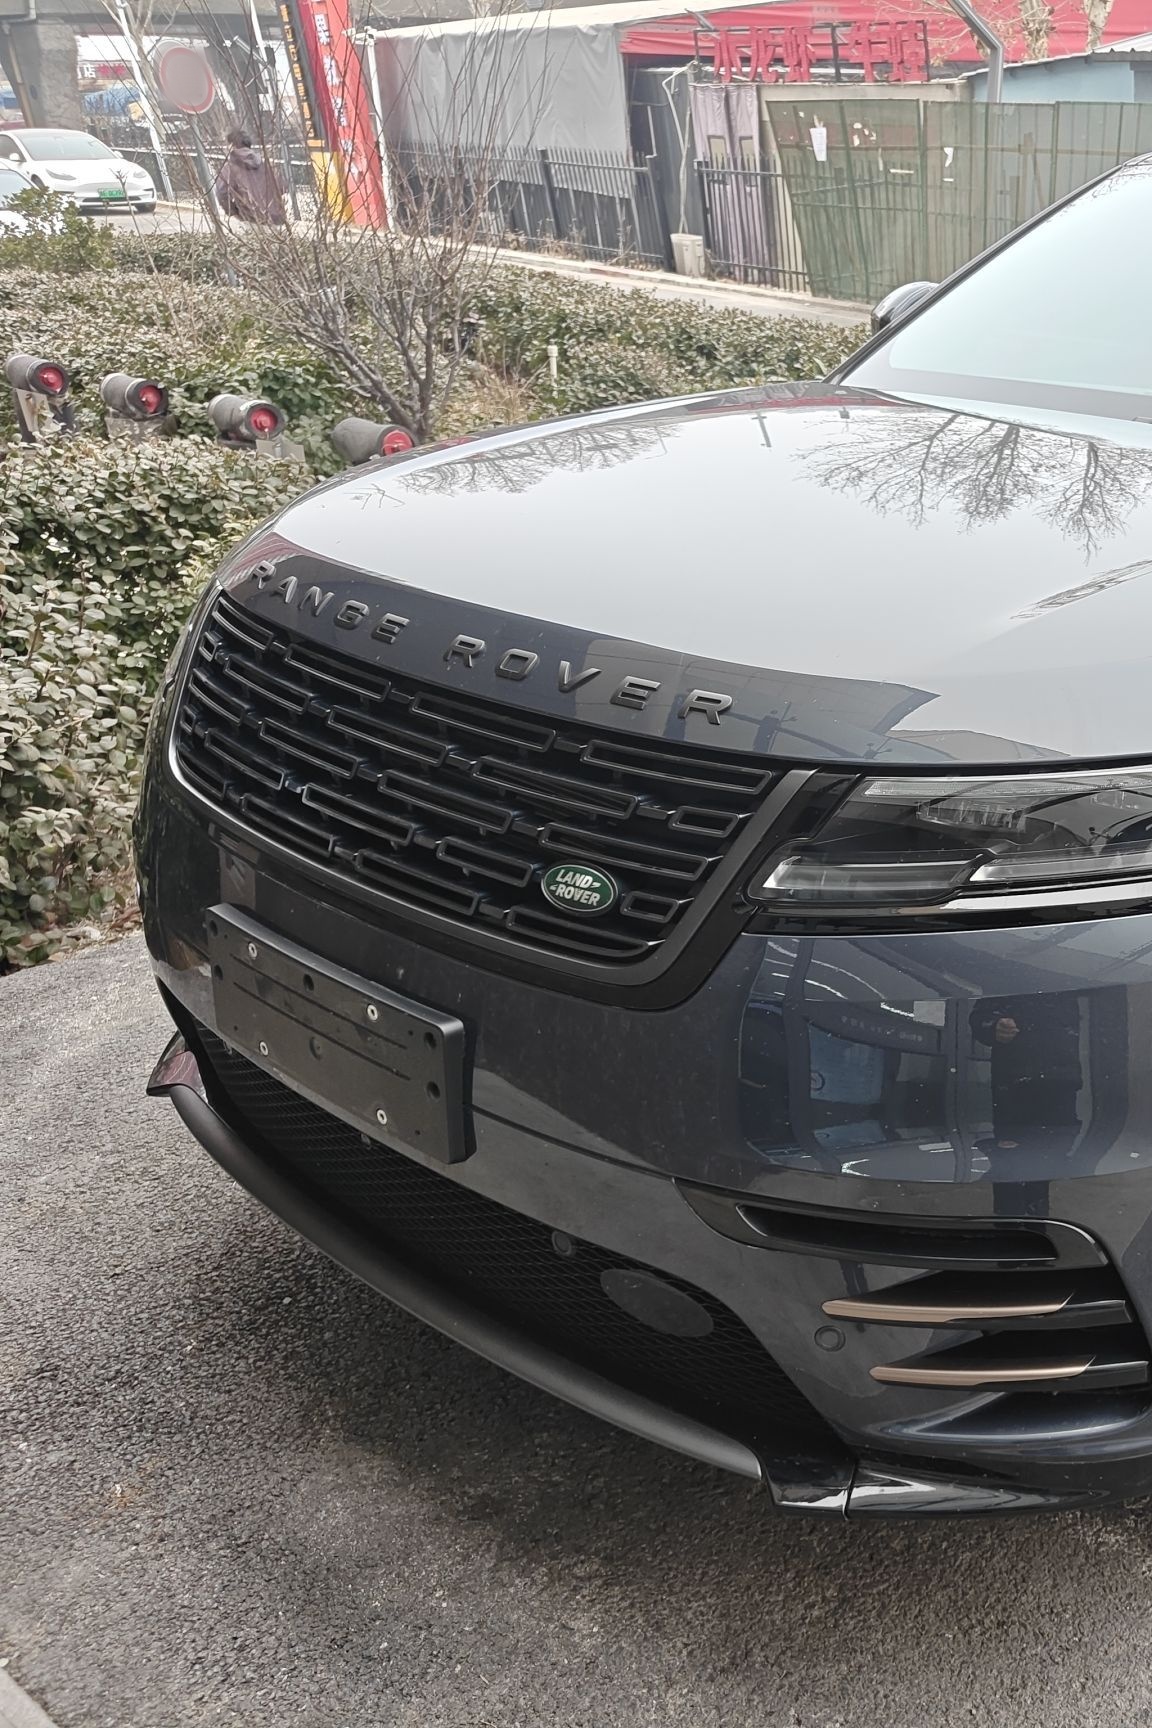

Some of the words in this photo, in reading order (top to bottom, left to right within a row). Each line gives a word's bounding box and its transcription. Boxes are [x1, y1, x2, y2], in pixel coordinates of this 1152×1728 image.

[249, 560, 411, 644] RANGE
[443, 633, 734, 726] ROVER
[555, 869, 594, 889] LAND
[555, 883, 601, 906] ROVER
